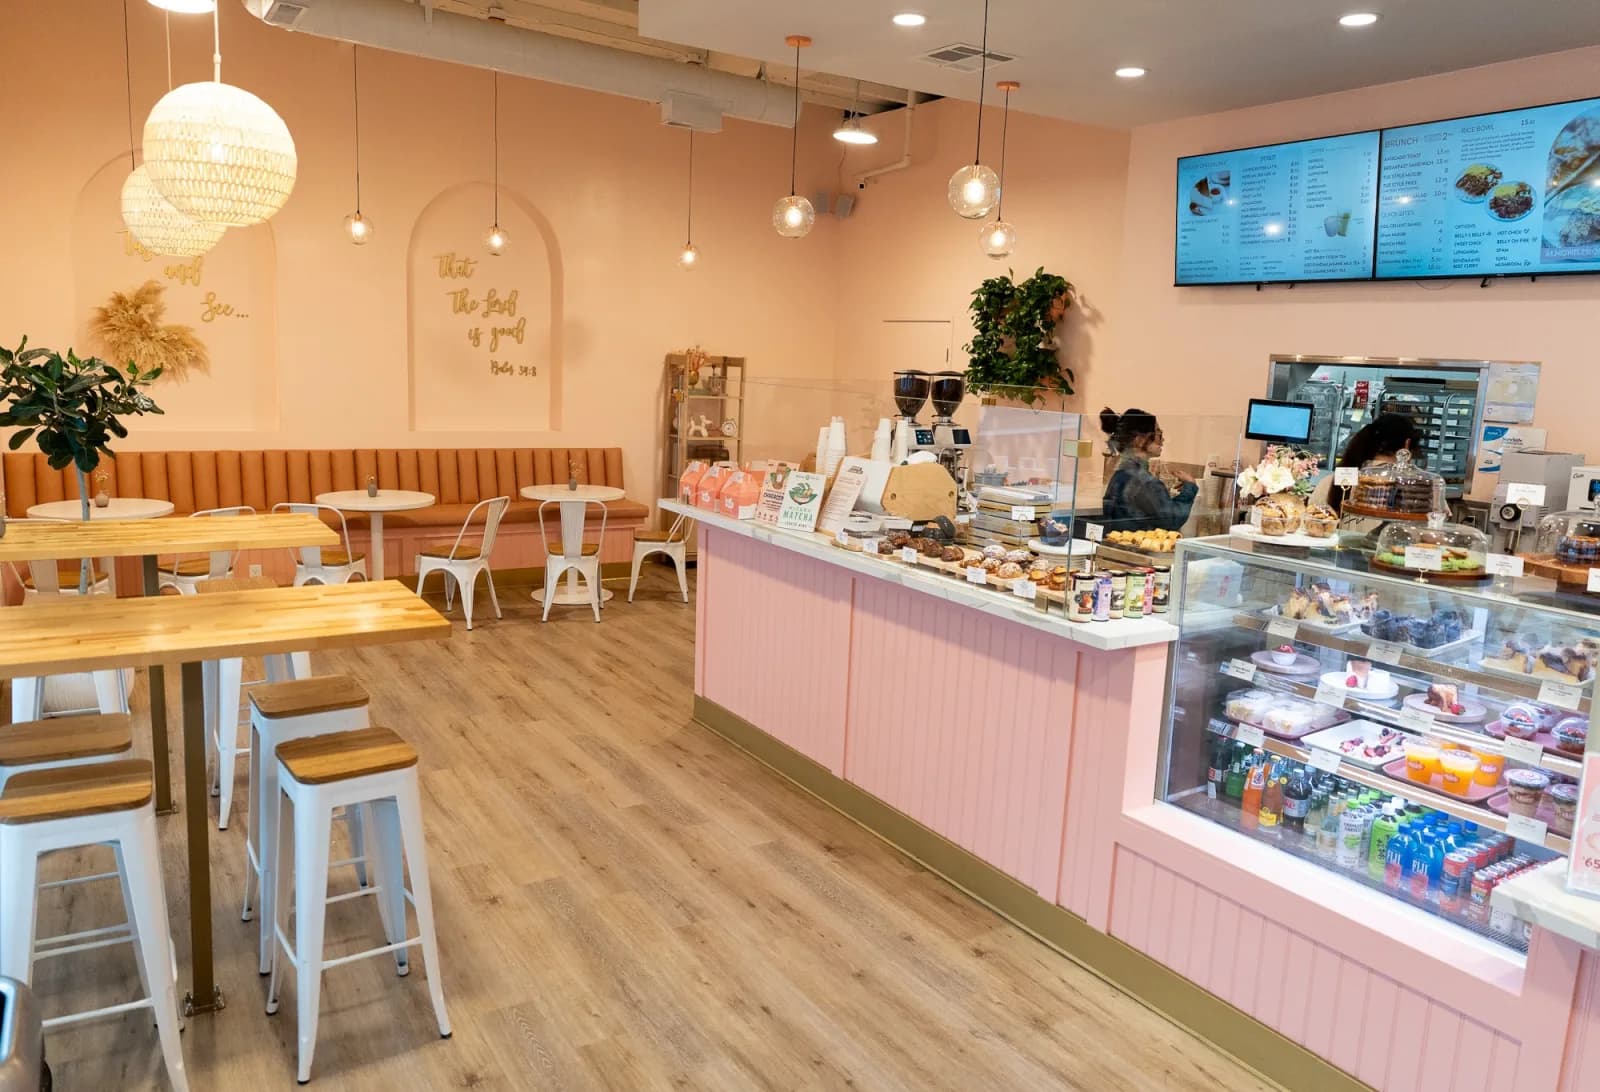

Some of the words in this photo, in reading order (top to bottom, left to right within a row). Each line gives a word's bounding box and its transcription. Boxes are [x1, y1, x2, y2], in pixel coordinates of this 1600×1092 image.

[1383, 136, 1418, 148] BRUNCH
[163, 255, 203, 287] and
[433, 251, 479, 279] That
[445, 287, 479, 314] The
[480, 287, 519, 318] Lord
[489, 316, 527, 353] good
[782, 509, 813, 522] MATCHA
[1386, 848, 1401, 865] FIJI
[1412, 859, 1428, 875] FIJI
